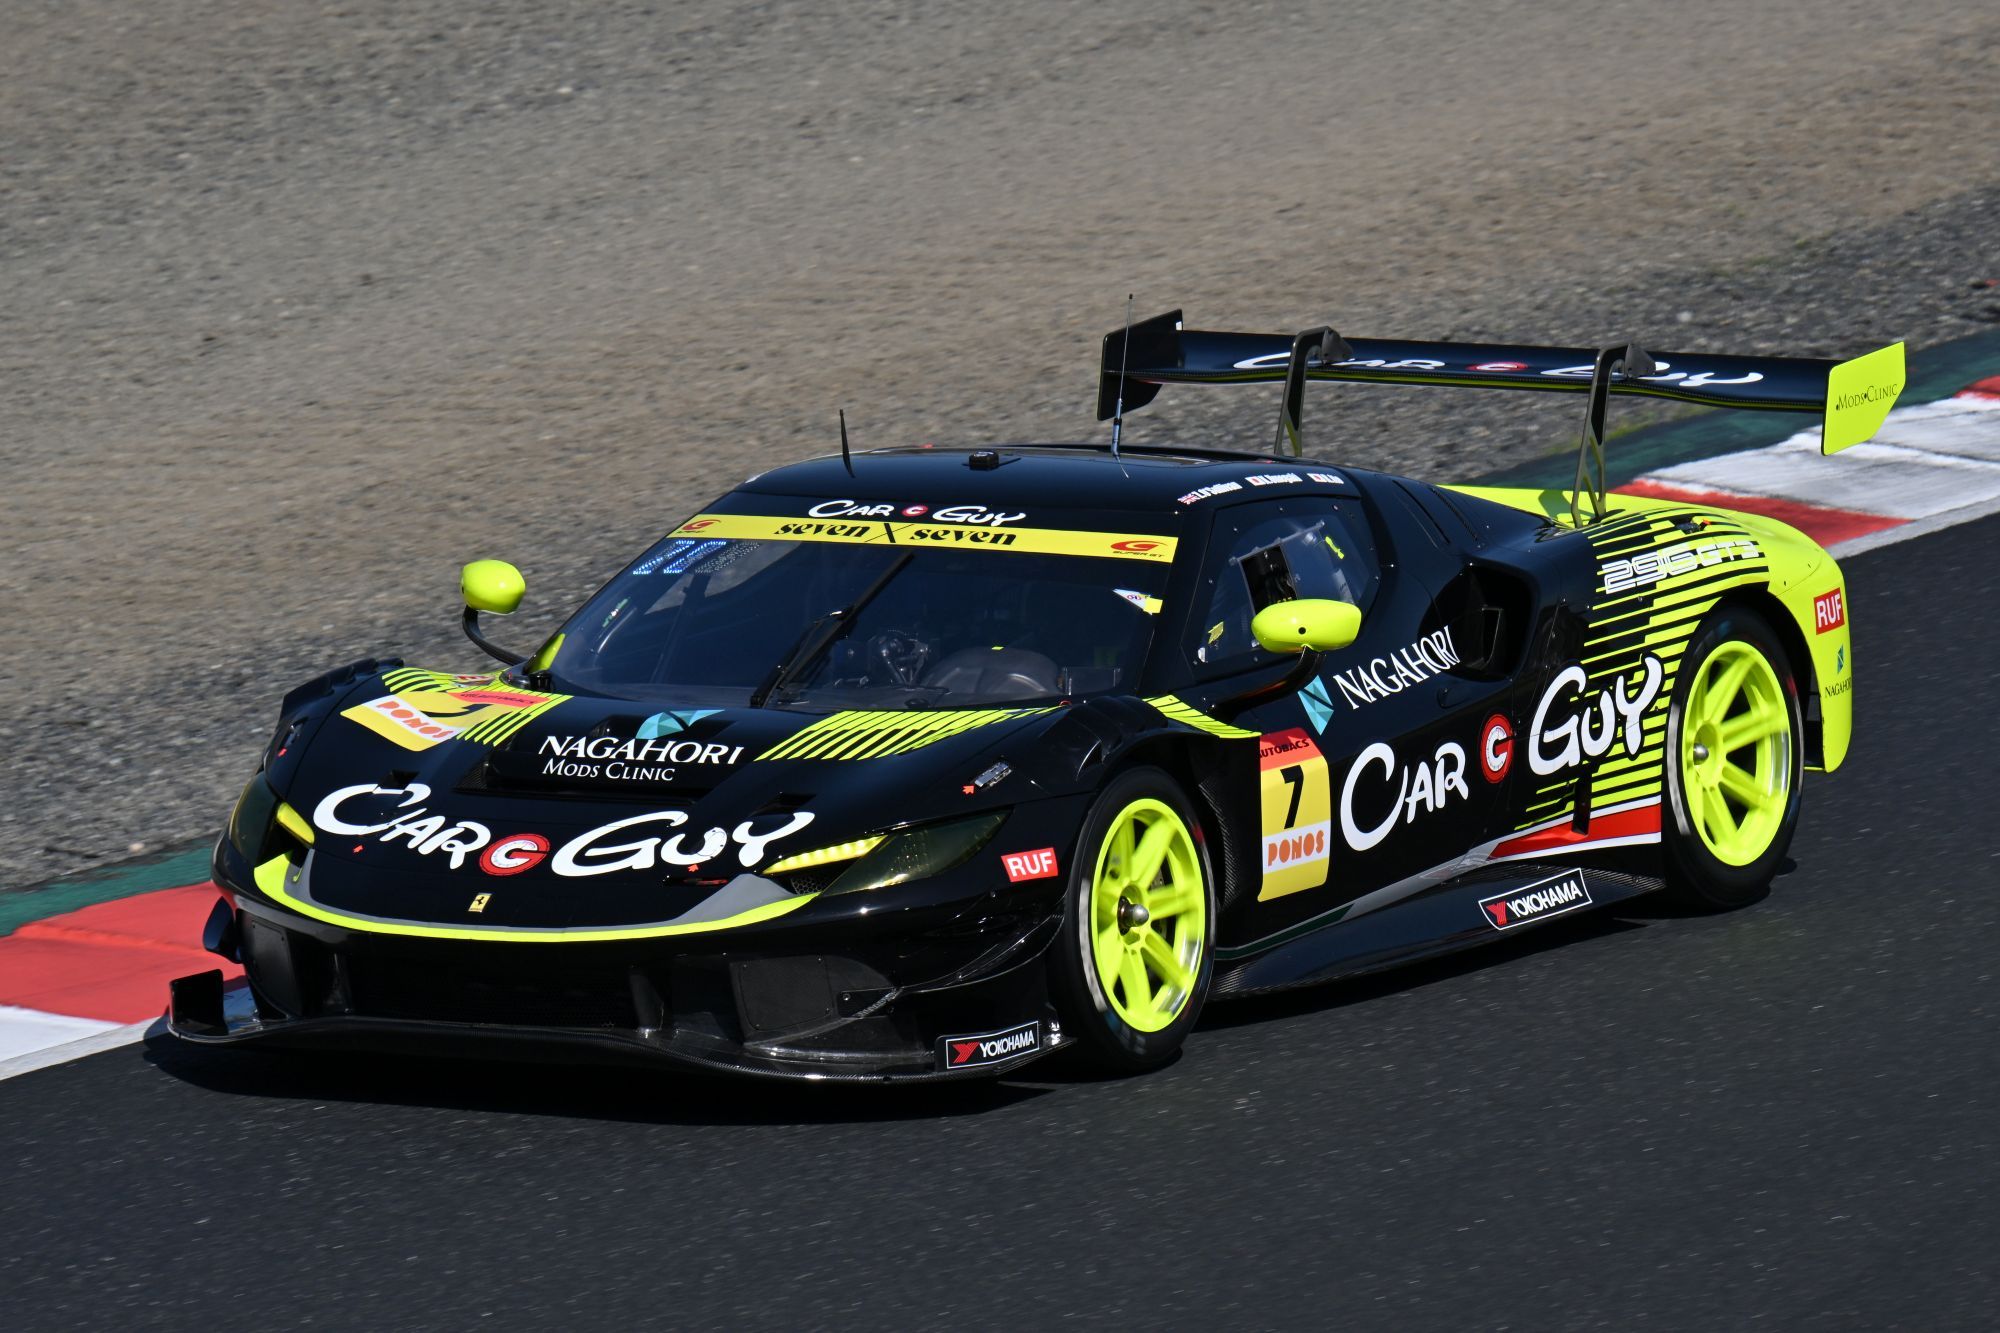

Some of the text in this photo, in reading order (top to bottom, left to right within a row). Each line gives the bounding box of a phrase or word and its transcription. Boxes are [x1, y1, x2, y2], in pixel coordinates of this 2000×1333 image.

[1838, 383, 1898, 411] MODS CLINIC
[808, 500, 895, 517] CAR
[932, 506, 1026, 527] GUY
[774, 523, 871, 537] seven
[910, 528, 1017, 546] seven
[1816, 593, 1842, 628] RUF
[1332, 625, 1461, 710] NAGAHORI
[376, 700, 454, 739] PONOS
[538, 735, 744, 765] NAGAHORI
[1260, 739, 1310, 758] UTOBACS
[1340, 742, 1468, 851] CAR
[1528, 656, 1662, 776] GUY
[542, 757, 676, 781] MODS CLINIC
[1280, 764, 1304, 829] 7
[313, 783, 491, 870] CAR
[551, 810, 815, 877] GUY
[1006, 851, 1053, 877] RUF
[1267, 830, 1324, 867] PONOS
[1506, 879, 1583, 918] YOKOHAMA
[980, 1030, 1035, 1058] YOKOHAMA
